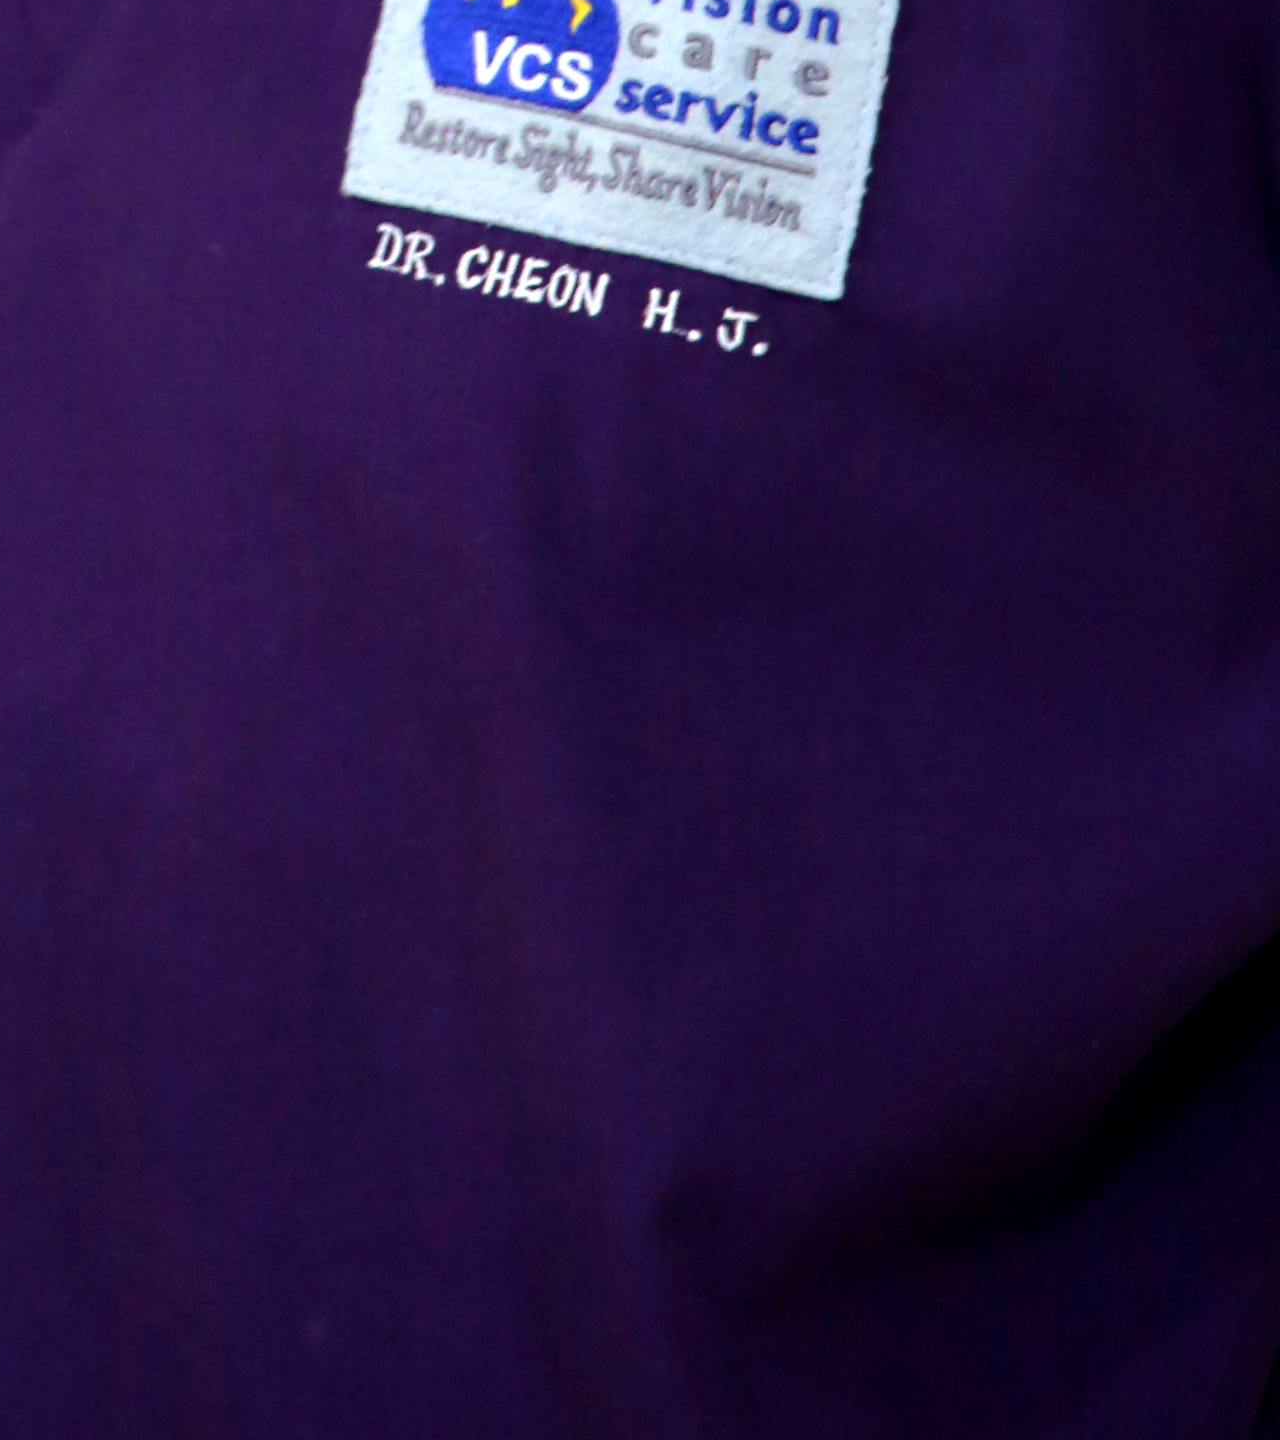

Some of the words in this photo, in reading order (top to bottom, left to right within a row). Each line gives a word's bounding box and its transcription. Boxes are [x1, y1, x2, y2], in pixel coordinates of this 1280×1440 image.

[472, 30, 593, 101] VCS
[628, 22, 831, 98] care
[615, 79, 819, 155] service
[398, 99, 510, 165] Restore
[601, 141, 699, 208] Share
[703, 165, 802, 231] Vision
